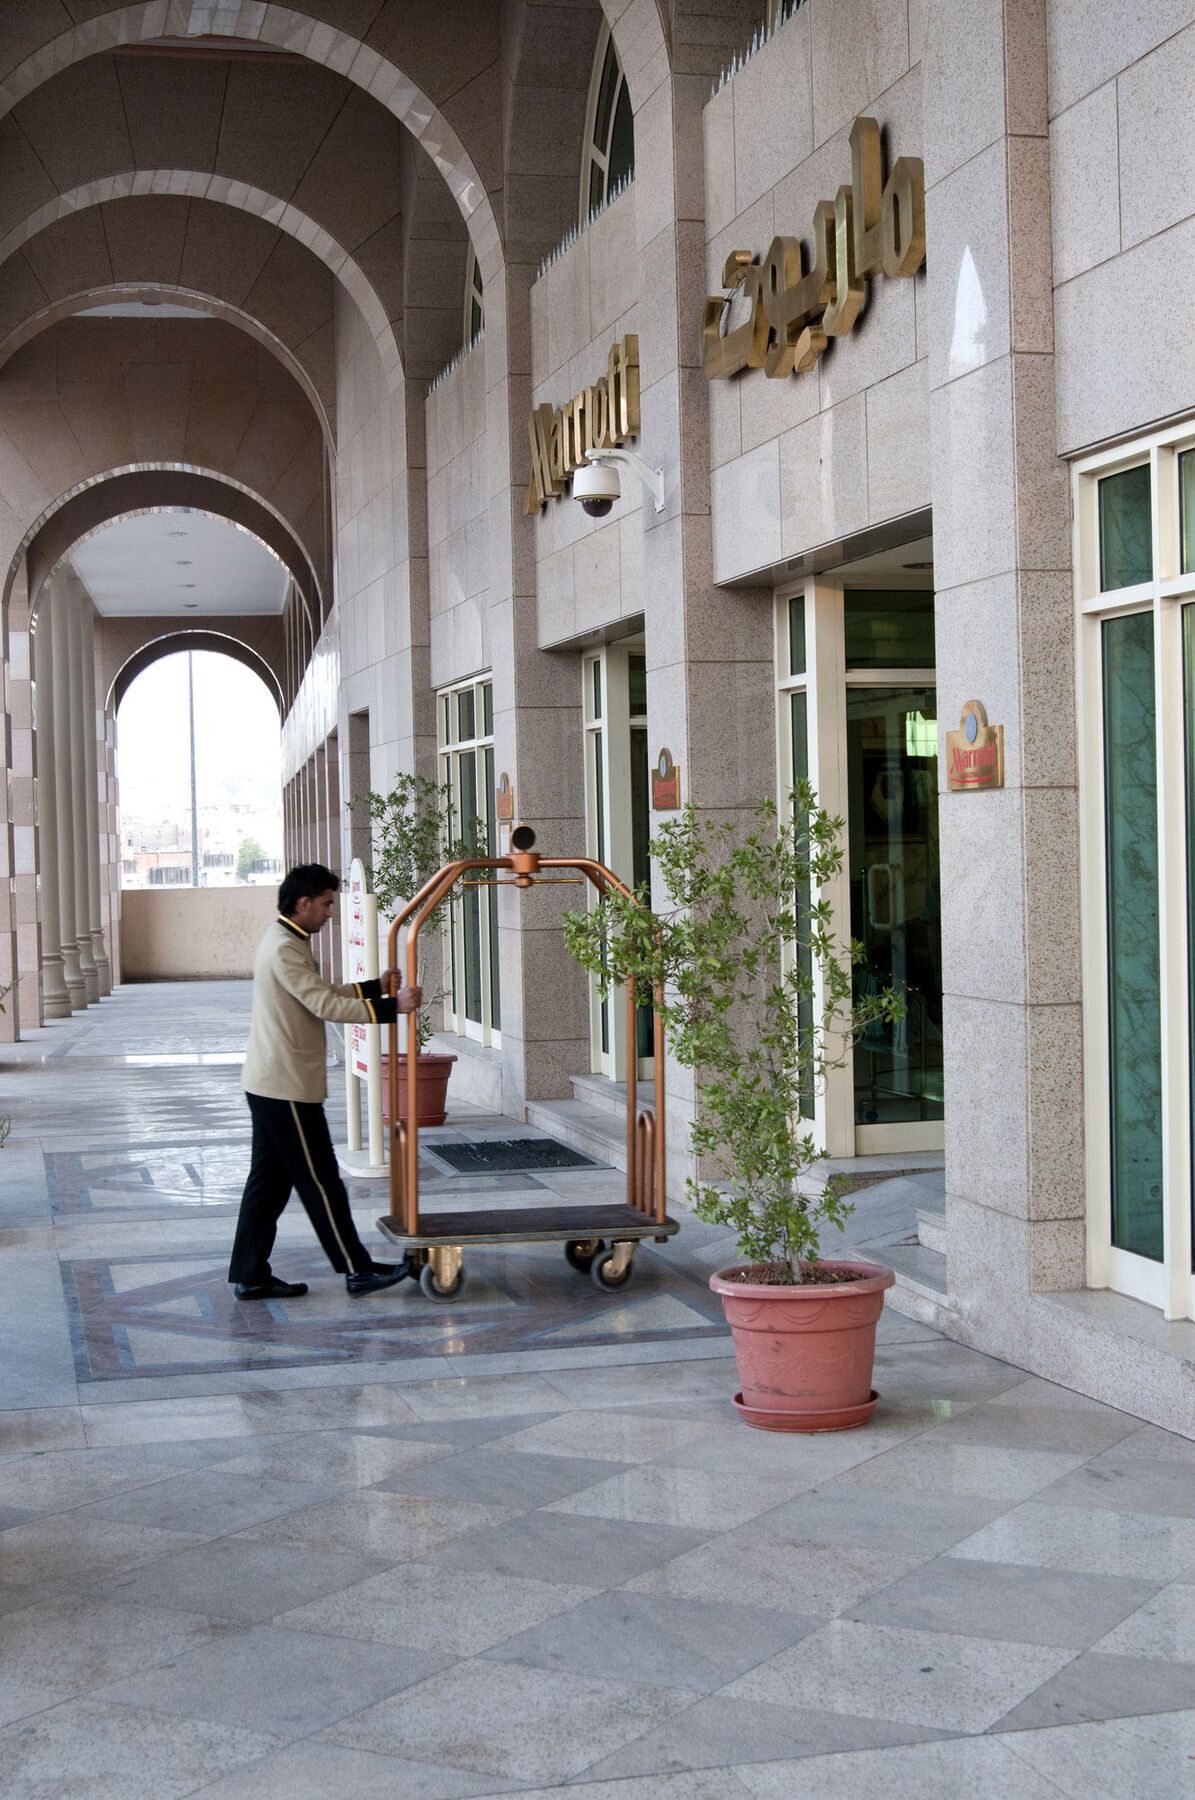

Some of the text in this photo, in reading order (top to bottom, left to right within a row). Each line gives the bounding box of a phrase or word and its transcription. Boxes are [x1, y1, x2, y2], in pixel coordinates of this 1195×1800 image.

[703, 117, 927, 379] ماريوت
[525, 334, 640, 515] Marriott
[949, 742, 996, 774] Marriott
